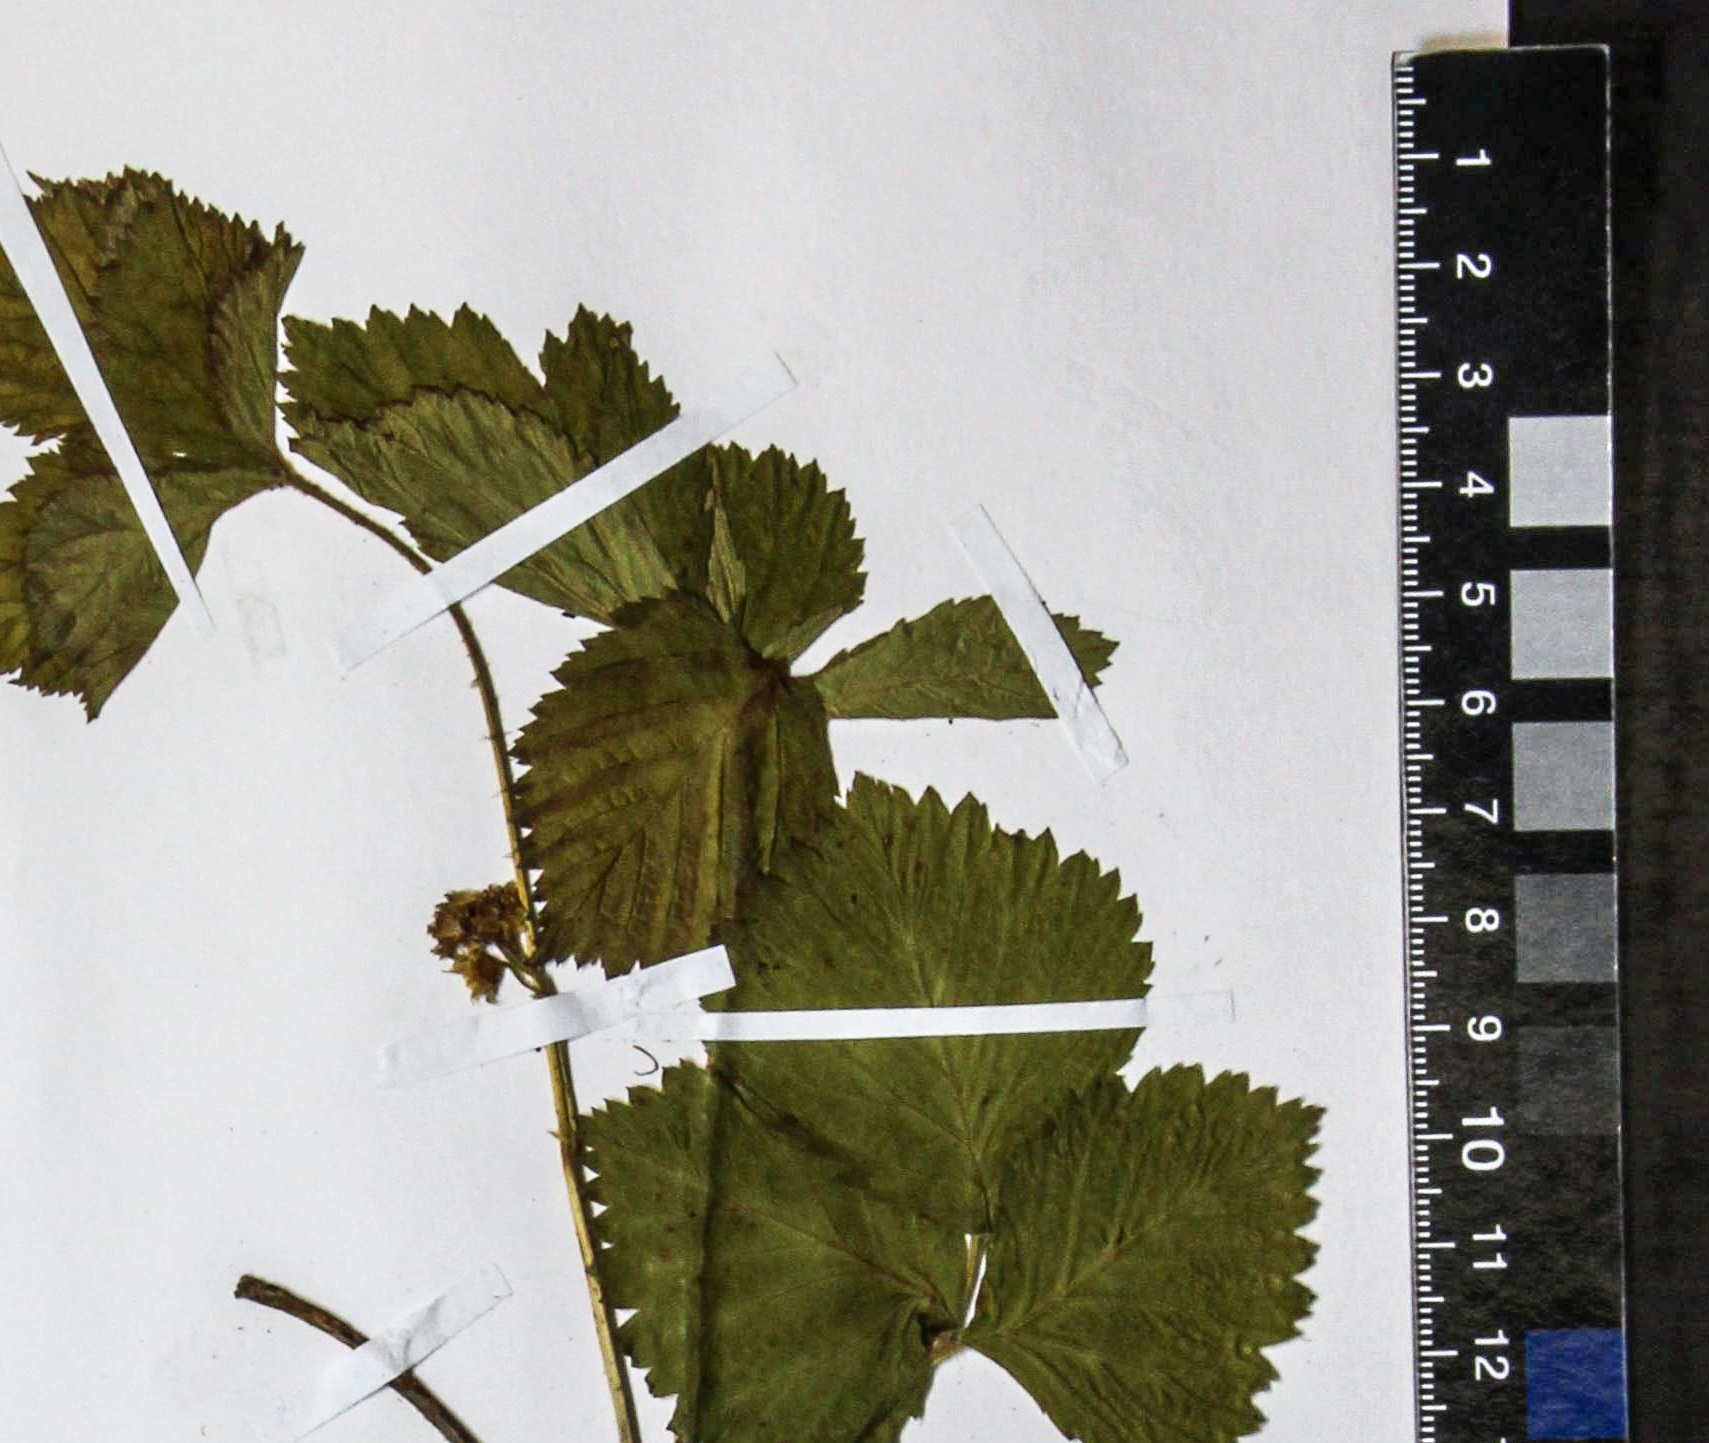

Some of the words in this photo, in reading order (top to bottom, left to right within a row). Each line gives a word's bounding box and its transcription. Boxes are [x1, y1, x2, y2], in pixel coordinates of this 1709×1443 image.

[1456, 149, 1490, 165] 1
[1457, 254, 1491, 278] 2
[1458, 363, 1493, 388] 3
[1460, 472, 1494, 497] 4
[1461, 582, 1495, 606] 5
[1462, 691, 1496, 715] 6
[1465, 799, 1498, 823] 7
[1465, 908, 1499, 933] 8
[1467, 1016, 1502, 1041] 9
[1462, 1107, 1505, 1170] 10
[1473, 1224, 1507, 1268] 11
[1475, 1330, 1509, 1380] 12
